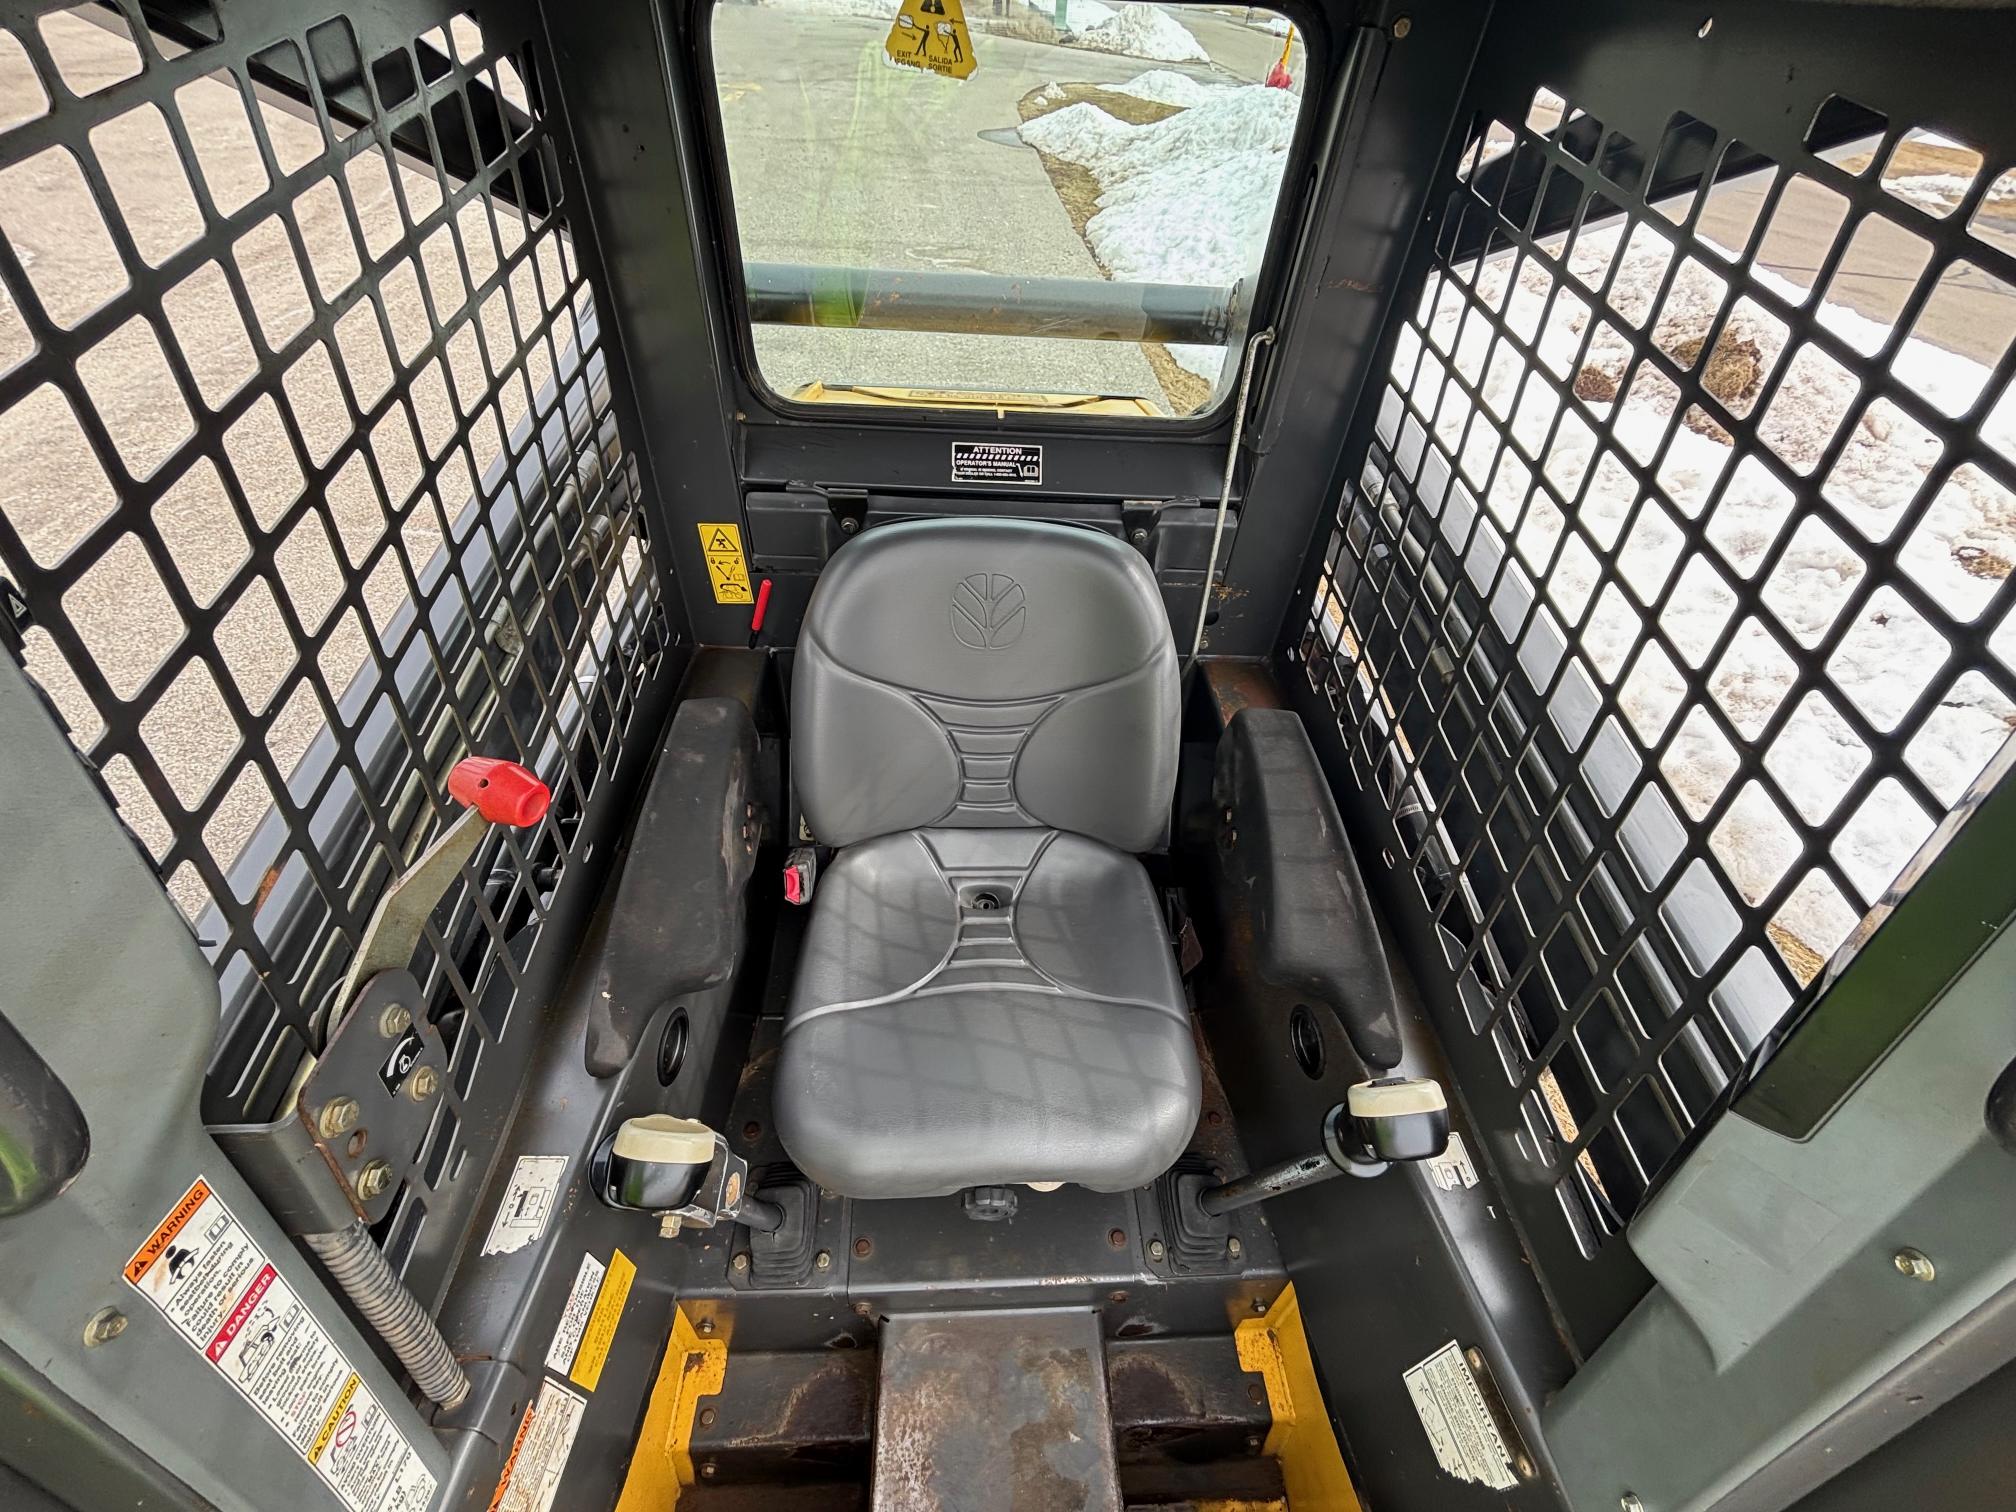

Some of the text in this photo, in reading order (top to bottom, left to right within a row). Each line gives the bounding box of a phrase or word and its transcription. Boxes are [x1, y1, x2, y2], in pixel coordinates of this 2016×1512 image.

[896, 50, 912, 59] EXIT
[928, 54, 953, 66] SALIDA
[973, 446, 1022, 455] ATTENTION
[146, 1187, 204, 1257] WARNING
[173, 1239, 225, 1308] Always fasten
[183, 1266, 221, 1318] operation.
[184, 1242, 249, 1328] Failure to comply
[190, 1259, 244, 1333] could result in
[194, 1256, 254, 1337] death or serious
[225, 1271, 271, 1338] DANGER
[320, 1377, 357, 1442] CAUTION
[394, 1450, 412, 1484] L170
